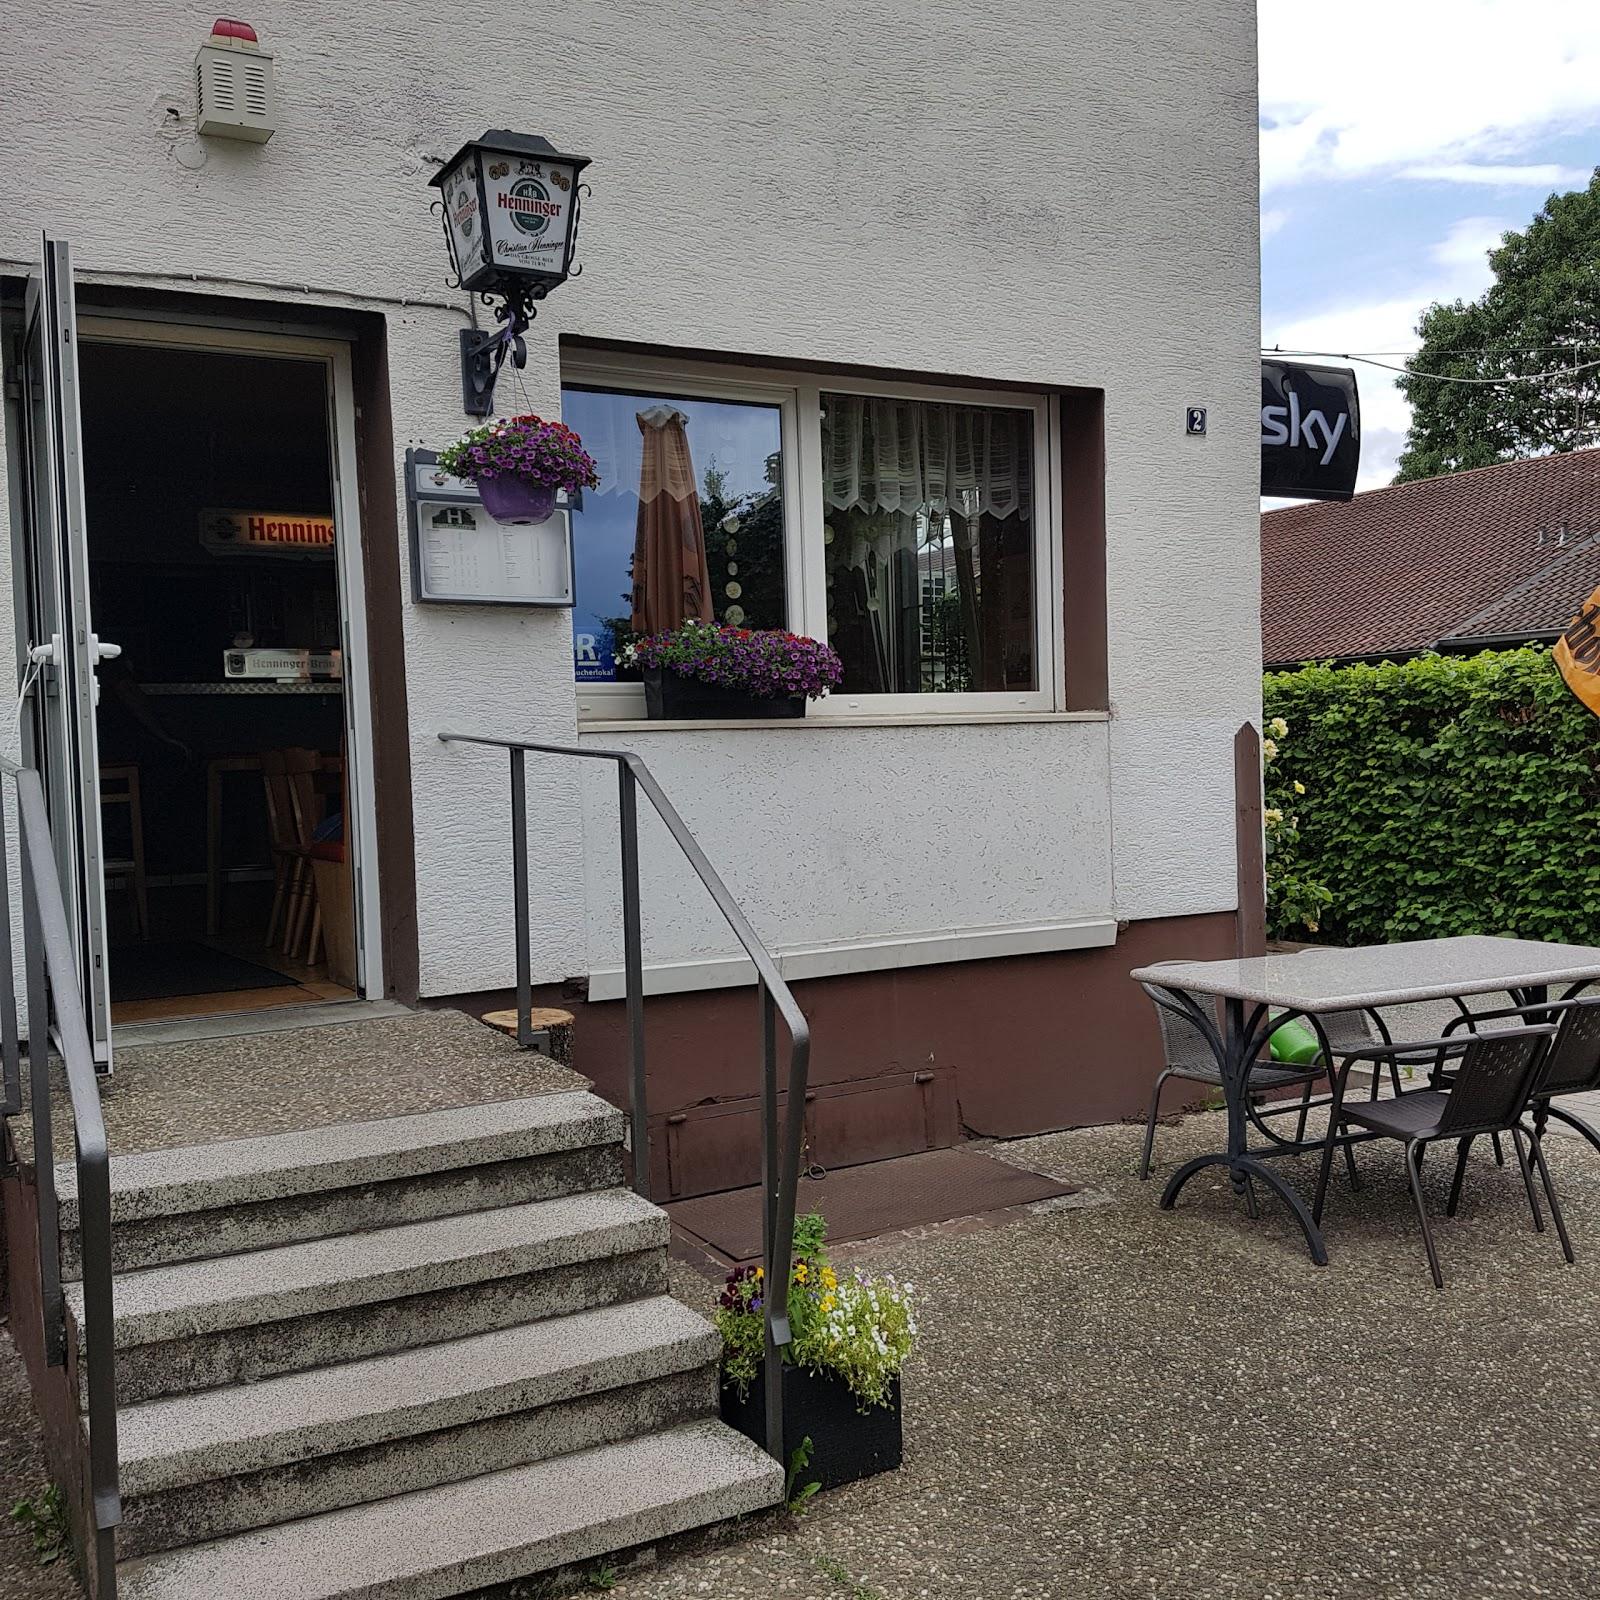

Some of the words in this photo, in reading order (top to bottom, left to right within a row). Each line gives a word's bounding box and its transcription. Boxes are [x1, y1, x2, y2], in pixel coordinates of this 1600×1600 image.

[498, 193, 562, 217] Henninger
[1192, 410, 1202, 431] 2
[1261, 391, 1347, 465] sky
[575, 668, 614, 676] ucherlokal
